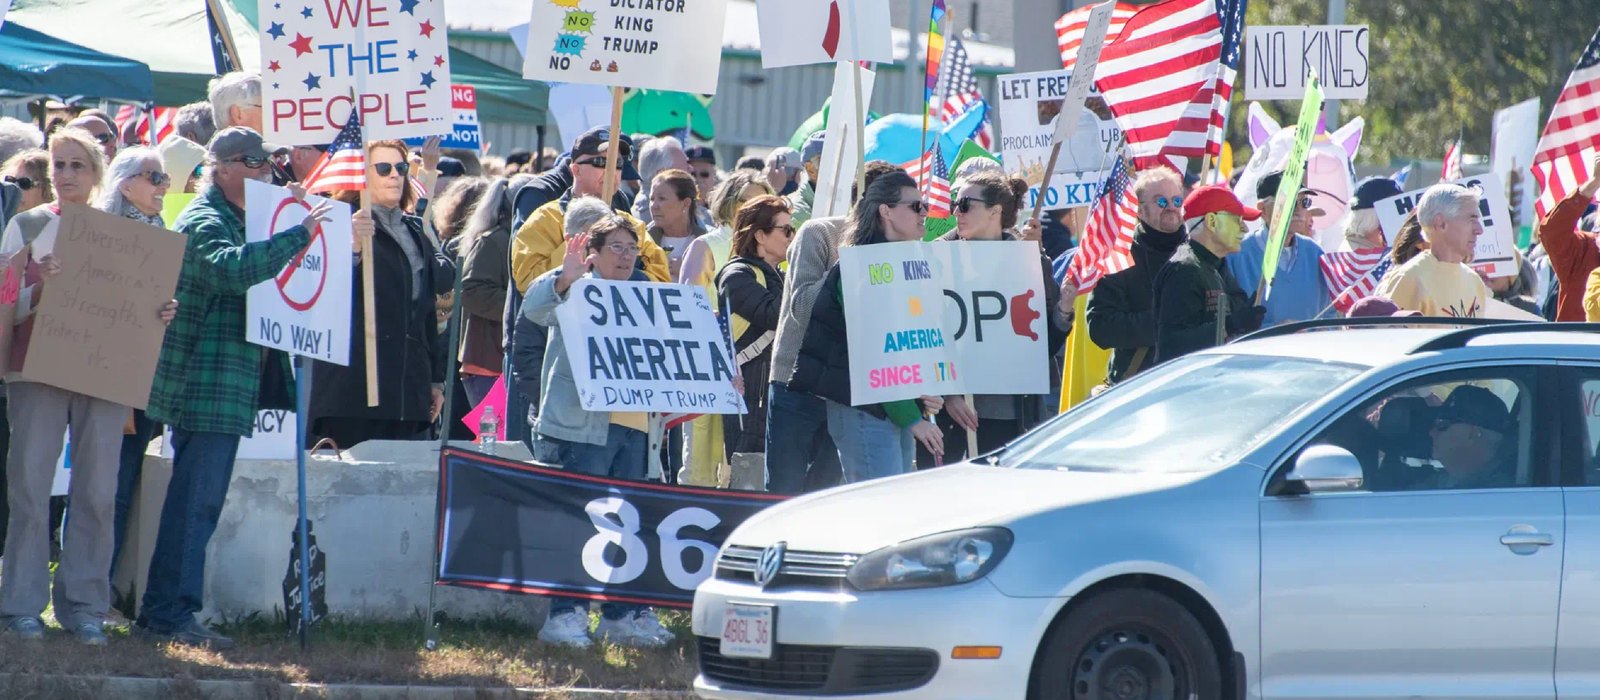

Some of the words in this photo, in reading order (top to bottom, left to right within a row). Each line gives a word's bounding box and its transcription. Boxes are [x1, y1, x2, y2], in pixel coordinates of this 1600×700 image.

[324, 0, 389, 29] WE
[567, 15, 589, 27] NO
[614, 15, 654, 33] KING
[318, 39, 400, 77] THE
[603, 36, 659, 54] TRUMP
[1253, 31, 1287, 89] NO
[1301, 27, 1369, 88] KINGS
[549, 56, 570, 71] NO
[452, 88, 474, 102] NG
[1001, 78, 1032, 101] LET
[68, 212, 154, 268] Diversity
[868, 262, 895, 286] NO
[902, 259, 932, 281] KINGS
[583, 284, 693, 330] SAVE
[260, 316, 283, 345] NO
[884, 327, 945, 354] AMERICA
[586, 336, 733, 382] AMERICA
[869, 364, 923, 390] SINCE
[603, 386, 654, 407] DUMP
[661, 390, 717, 408] TRUMP
[581, 496, 721, 591] 86
